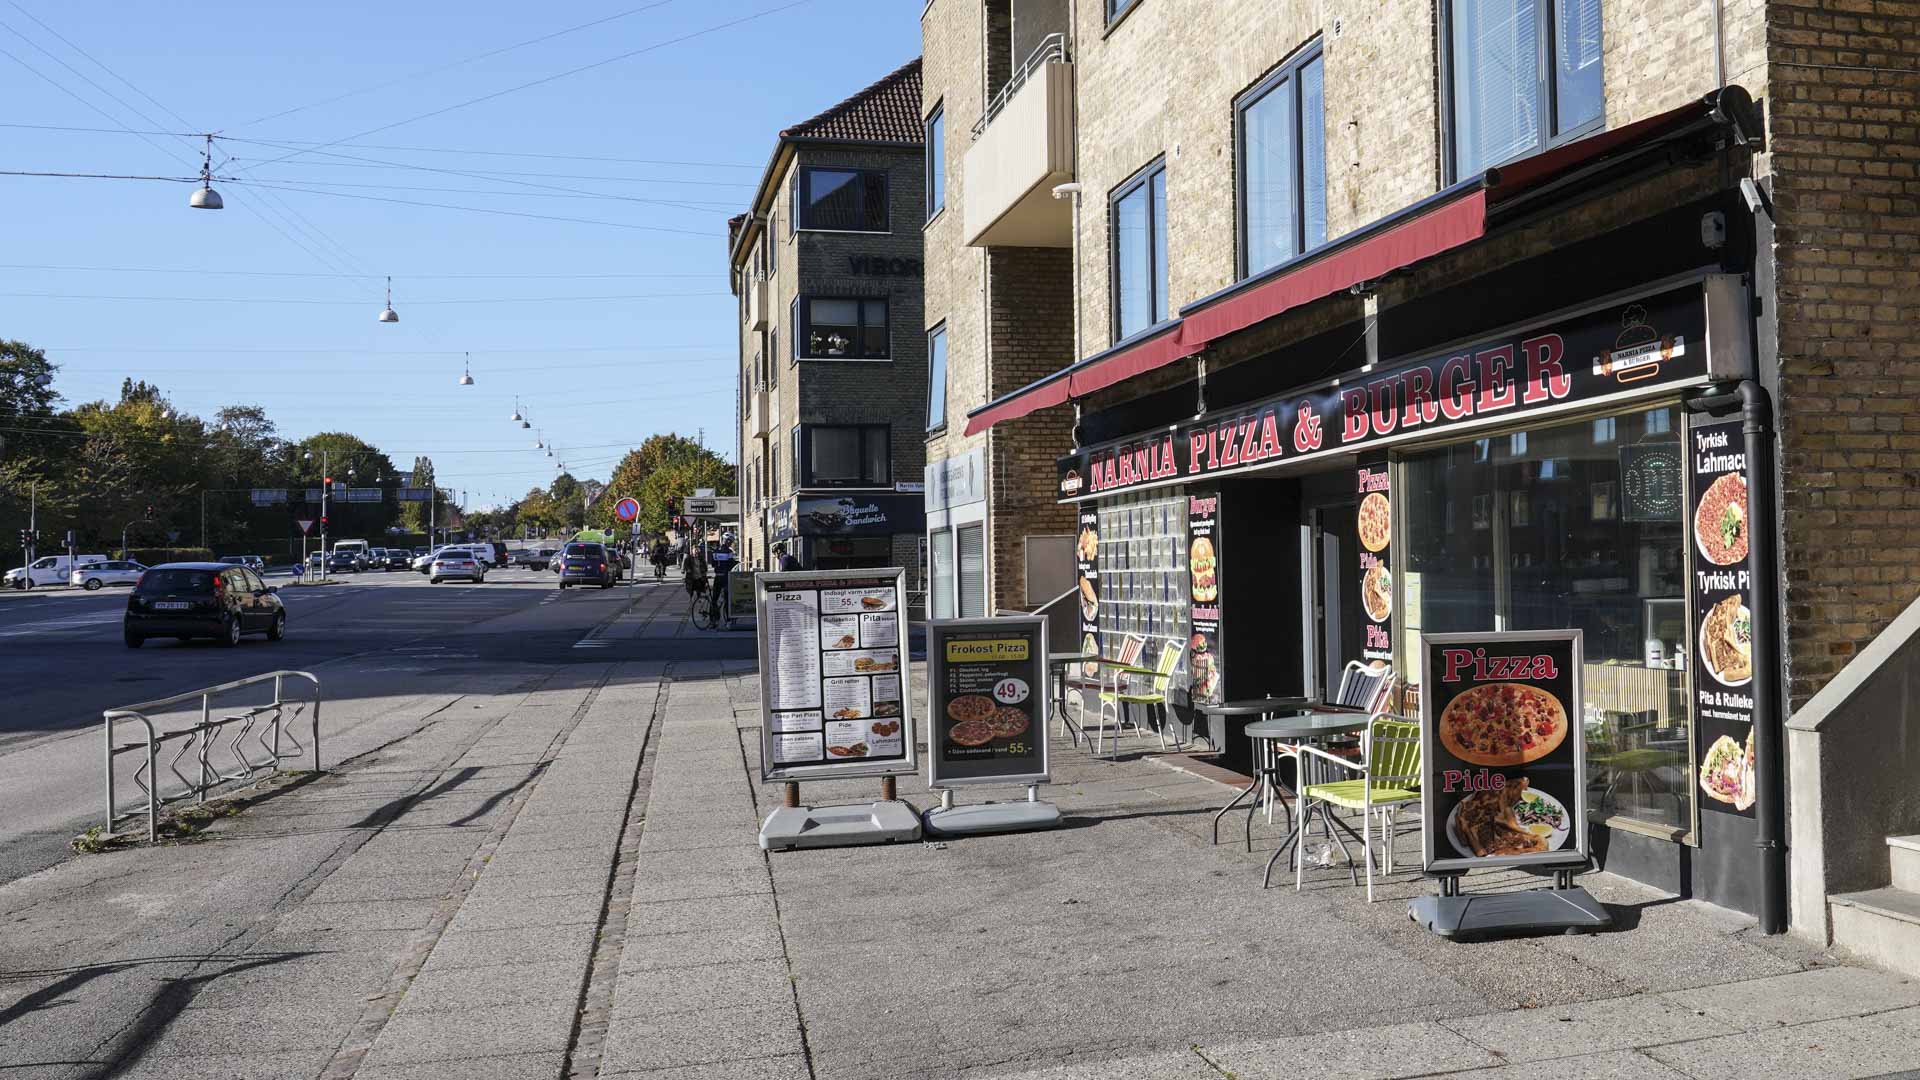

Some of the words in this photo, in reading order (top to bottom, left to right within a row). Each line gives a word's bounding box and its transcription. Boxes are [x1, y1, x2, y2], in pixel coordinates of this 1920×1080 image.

[1616, 348, 1639, 360] NARNIA
[1640, 344, 1656, 355] PIZZA
[1090, 431, 1178, 492] NARNIA
[1189, 410, 1282, 473] PIZZA
[1294, 400, 1322, 451] &
[1341, 333, 1571, 442] BURGER
[1696, 432, 1728, 452] Tyrkisk
[1358, 468, 1390, 493] Pizza
[840, 503, 880, 517] Baguette
[1190, 496, 1217, 519] Burger
[845, 513, 887, 526] Sandwich
[1697, 570, 1736, 594] Tyrkisk
[776, 593, 802, 602] Pizza
[841, 598, 858, 607] 55,-
[863, 614, 881, 622] Pita
[1367, 625, 1389, 649] Pita
[951, 644, 993, 654] Frokost
[997, 643, 1026, 653] Pizza
[1442, 648, 1558, 682] Pizza
[997, 682, 1028, 700] 49,-
[1699, 690, 1714, 705] Pita
[1715, 692, 1722, 706] &
[1723, 692, 1753, 709] Rulleke
[1442, 769, 1506, 792] Pide
